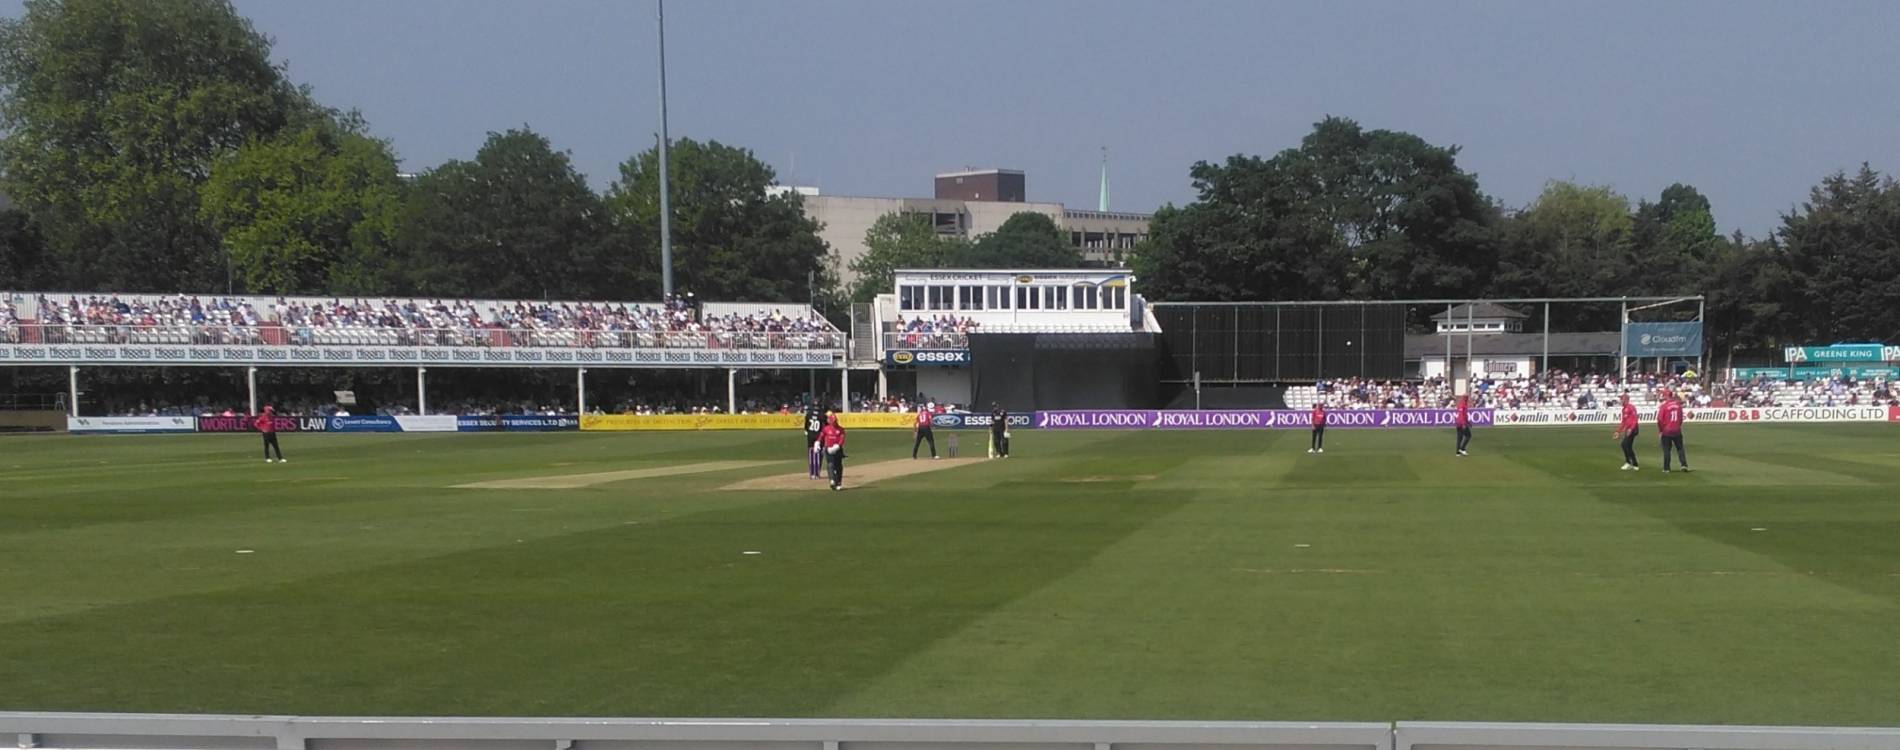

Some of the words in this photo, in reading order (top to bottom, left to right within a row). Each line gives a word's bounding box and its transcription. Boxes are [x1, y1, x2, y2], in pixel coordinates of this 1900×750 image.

[917, 352, 964, 361] essex
[1785, 347, 1807, 362] IPA
[1050, 414, 1090, 425] ROYAL
[1092, 414, 1146, 425] LONDON
[1164, 413, 1203, 425] ROYAL
[1206, 413, 1259, 425] LONDON
[1277, 413, 1313, 425] ROYA
[1326, 413, 1374, 424] ONDON
[1392, 412, 1432, 424] ROYAL
[1435, 411, 1490, 424] LOON
[1496, 414, 1509, 423] MS
[1554, 413, 1568, 422] MS
[1670, 410, 1678, 422] 11
[1764, 408, 1857, 420] SCAFFOLDING
[1860, 409, 1884, 419] LTD
[201, 418, 249, 430] WORTLE
[301, 418, 326, 430] LAW
[809, 419, 820, 431] 20
[965, 416, 992, 425] ESSE
